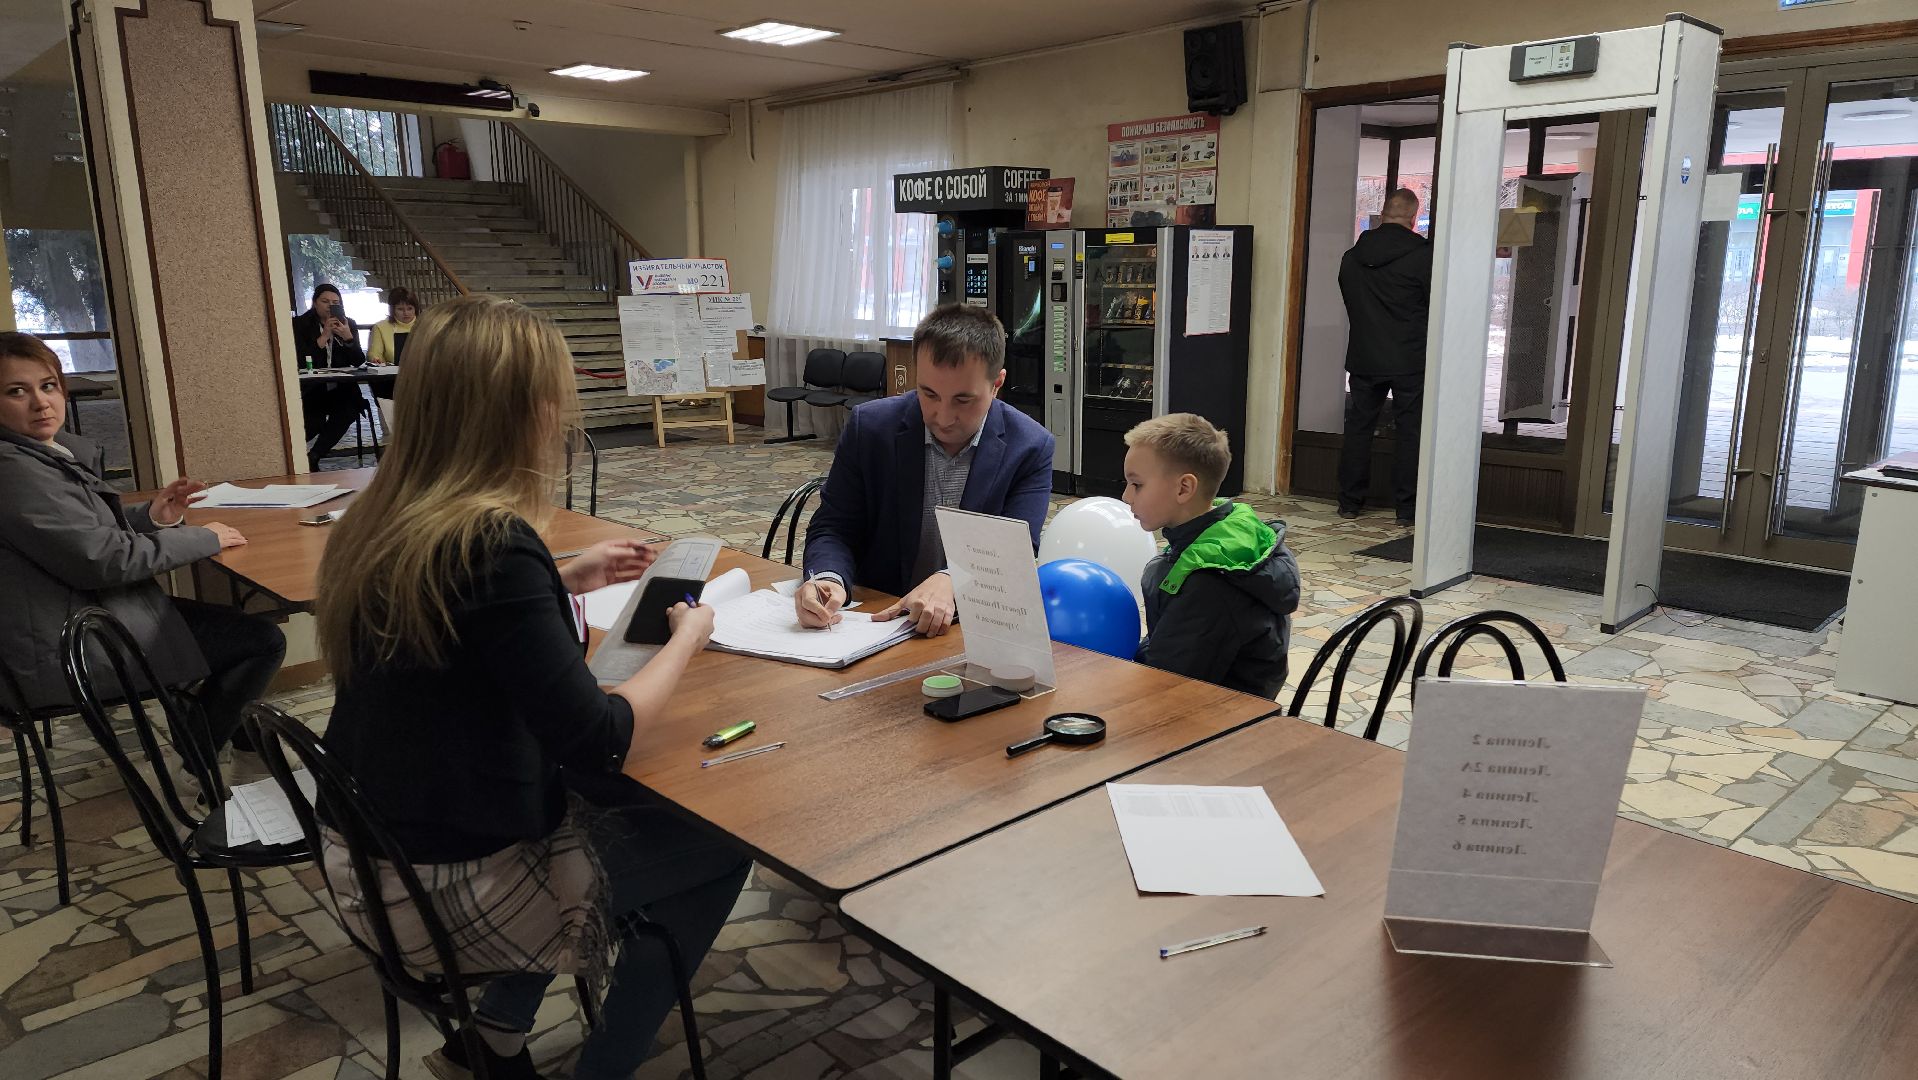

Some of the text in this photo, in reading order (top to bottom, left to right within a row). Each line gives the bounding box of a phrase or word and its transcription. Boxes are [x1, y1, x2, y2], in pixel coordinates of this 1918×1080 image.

[1121, 116, 1205, 138] ПОЖАРНАЯ БЕЗОПАСНОСТЬ
[899, 168, 987, 202] КОФЕ С СОБОЙ
[1004, 191, 1013, 203] ЗА
[632, 262, 724, 272] ИЗБИРАТЕЛЬНЫЙ УЧАСТОК
[700, 274, 725, 287] 221
